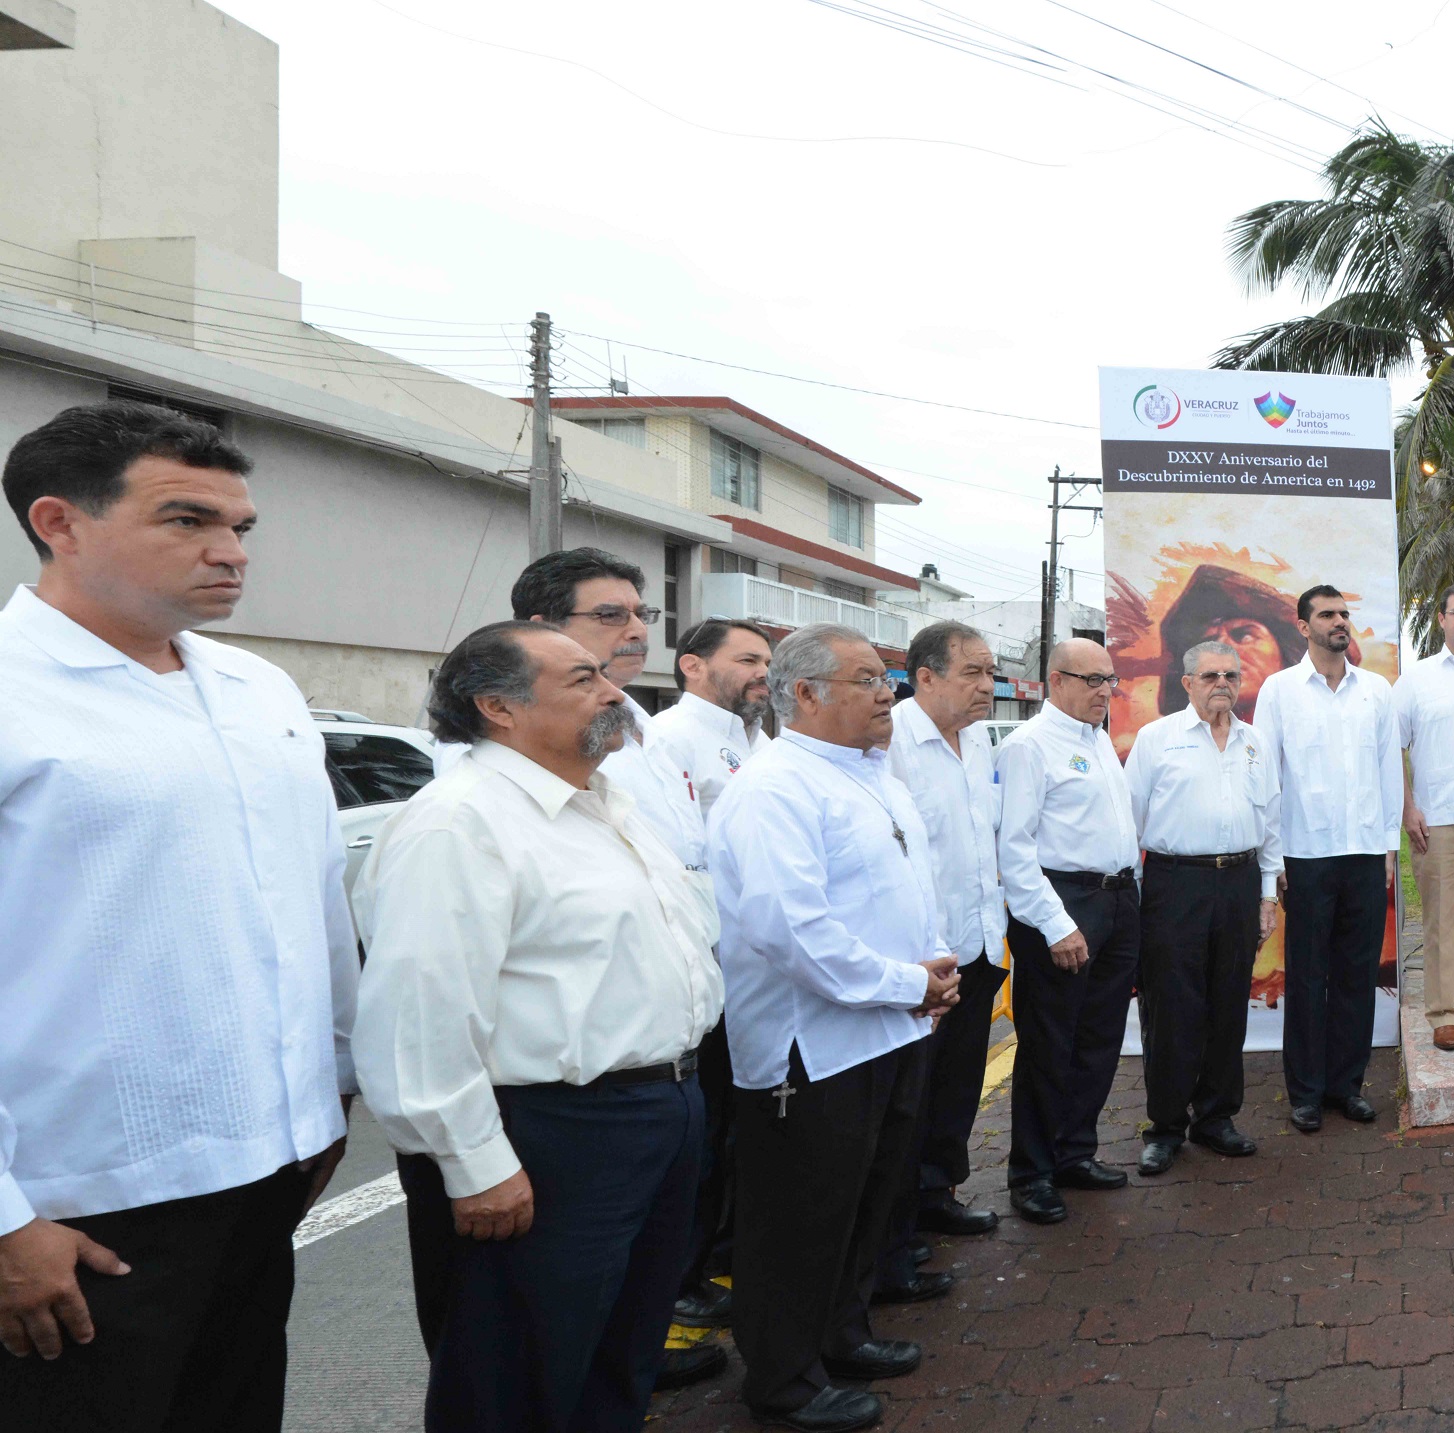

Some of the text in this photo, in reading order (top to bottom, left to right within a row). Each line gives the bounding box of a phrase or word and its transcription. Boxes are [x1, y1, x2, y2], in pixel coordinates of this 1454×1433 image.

[1184, 399, 1239, 411] VERACRUZ
[1296, 409, 1350, 421] Trabajamos
[1296, 419, 1328, 429] Juntos
[1167, 450, 1328, 469] DXXV Aniversario del
[1118, 469, 1376, 491] Descubrimiento de America en 1492
